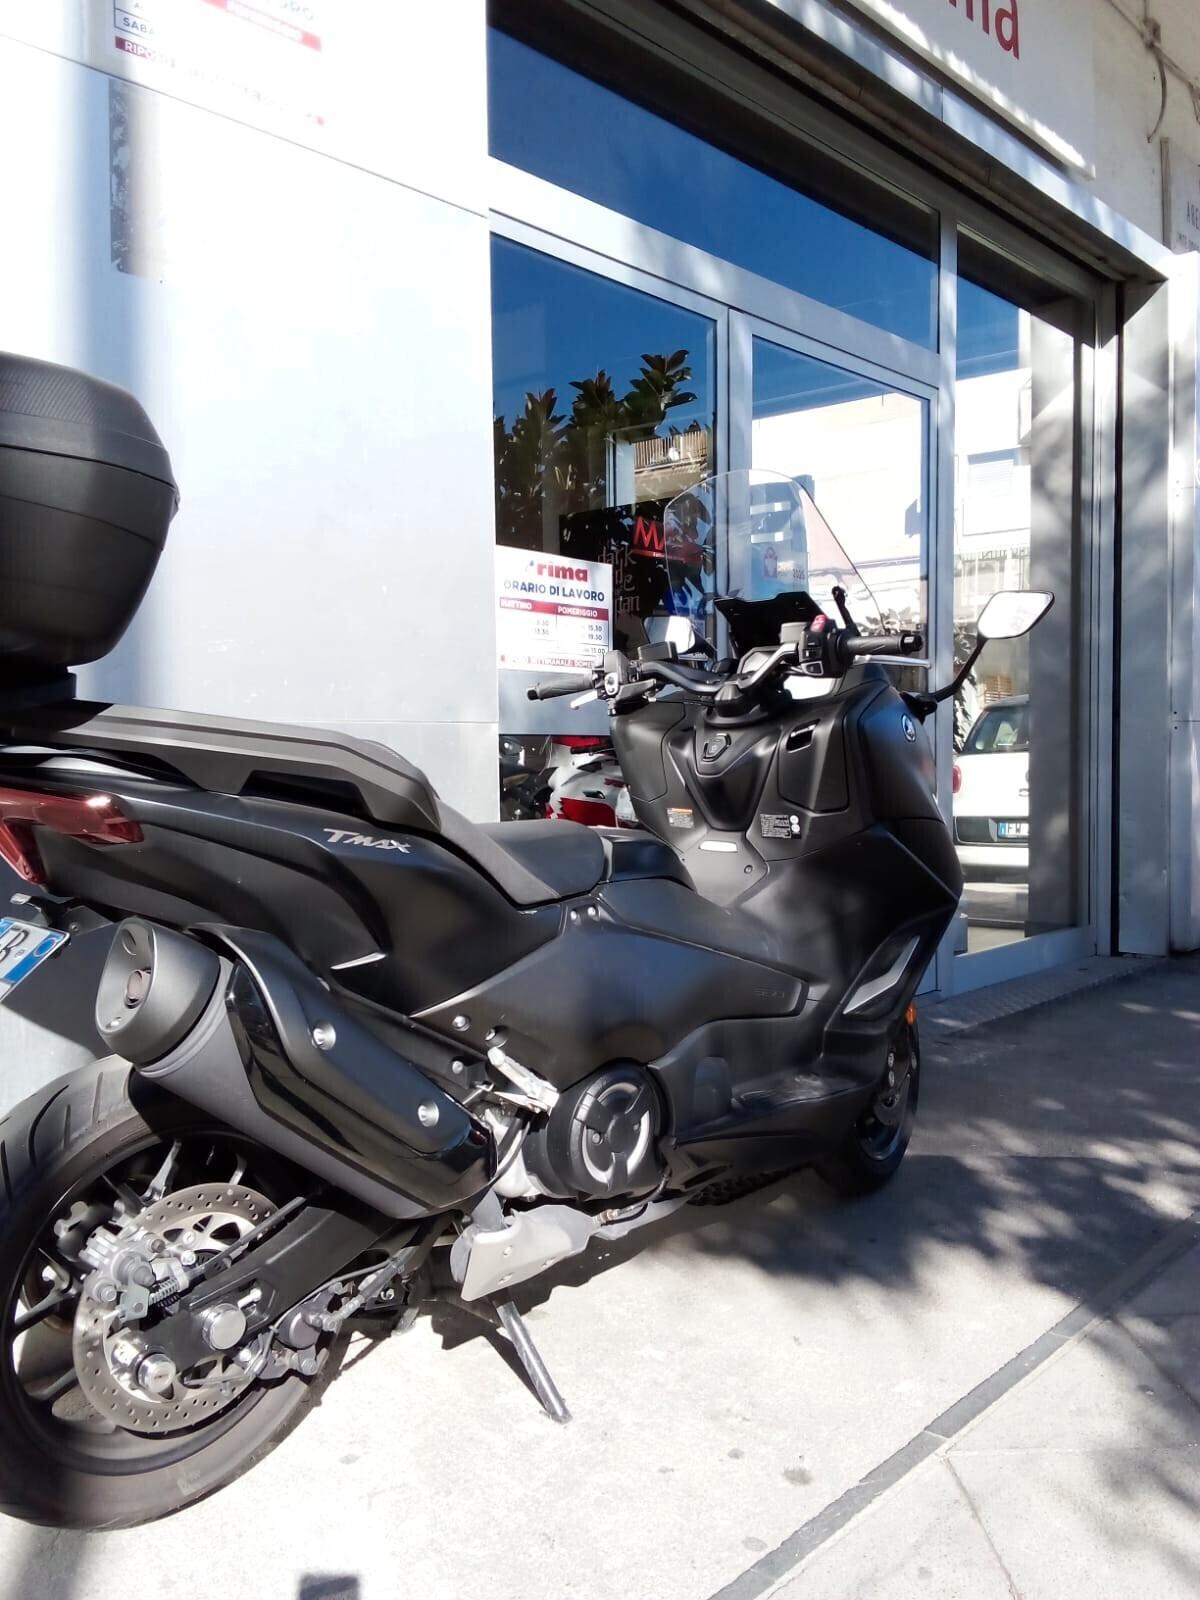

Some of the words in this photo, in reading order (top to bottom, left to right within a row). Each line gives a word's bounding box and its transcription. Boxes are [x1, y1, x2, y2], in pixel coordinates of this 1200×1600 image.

[504, 580, 546, 595] ORARIO
[549, 586, 560, 597] DI
[562, 587, 605, 602] LAVORO
[558, 606, 598, 618] POMERIGGIO
[323, 827, 411, 855] TMAX
